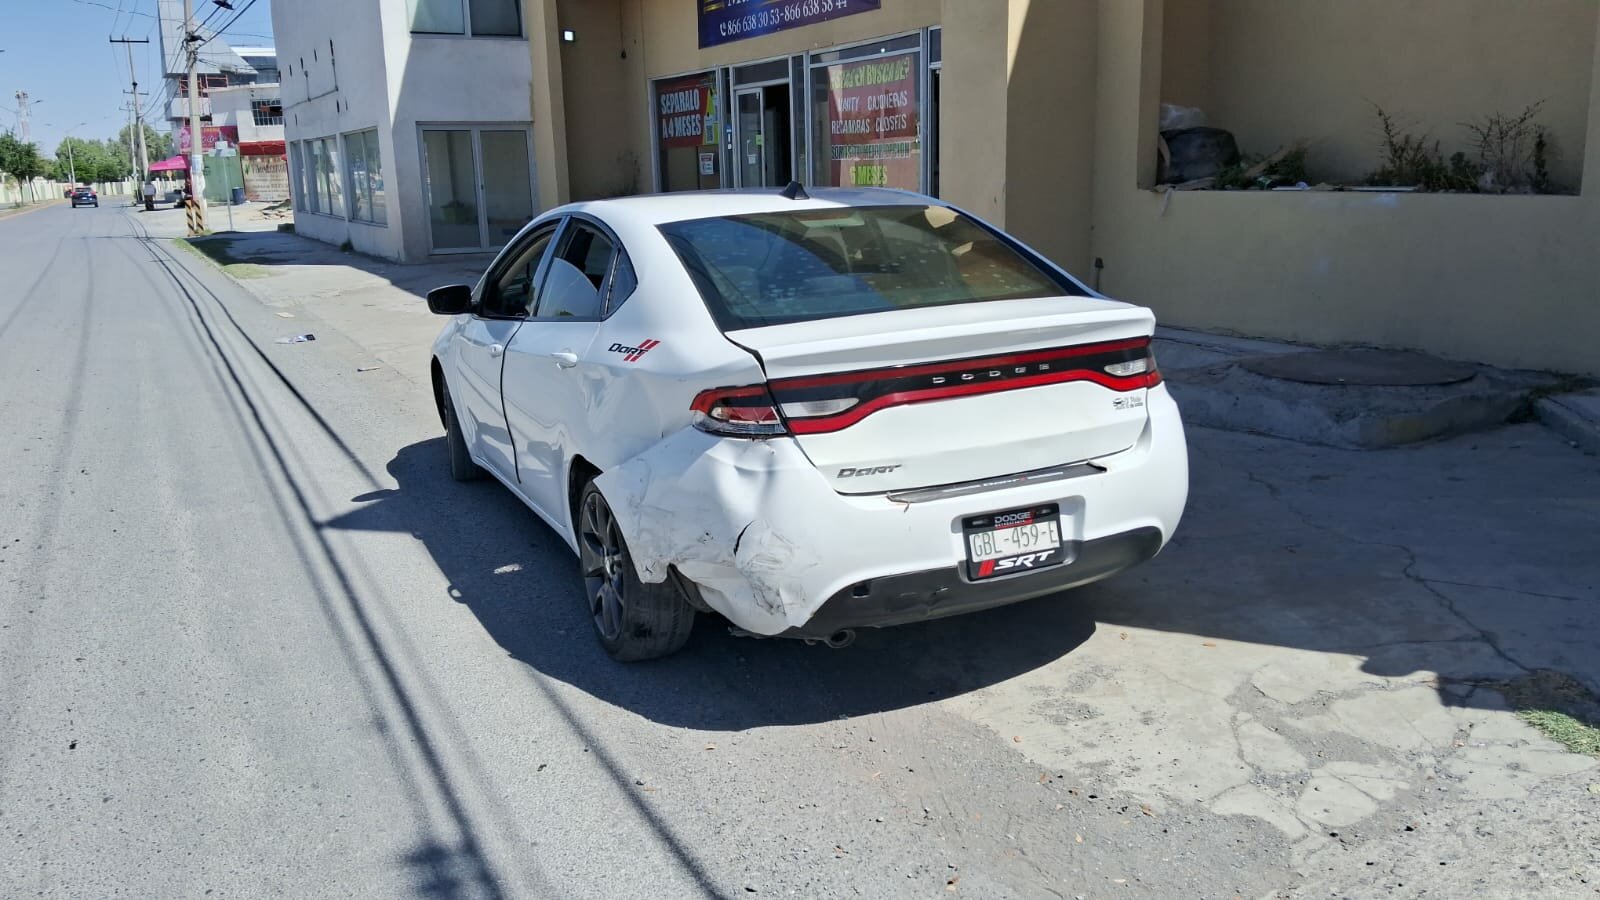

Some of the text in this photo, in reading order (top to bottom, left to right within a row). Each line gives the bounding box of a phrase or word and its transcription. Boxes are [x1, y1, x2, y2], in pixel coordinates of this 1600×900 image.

[728, 18, 741, 35] 866
[743, 14, 757, 32] 638
[758, 11, 769, 28] 30
[803, 0, 820, 17] 638
[822, 0, 833, 13] 58
[675, 114, 701, 137] MESES
[857, 165, 887, 185] MESES
[932, 363, 1050, 384] DODGE
[994, 512, 1031, 524] DODGE
[994, 550, 1055, 570] SRT
